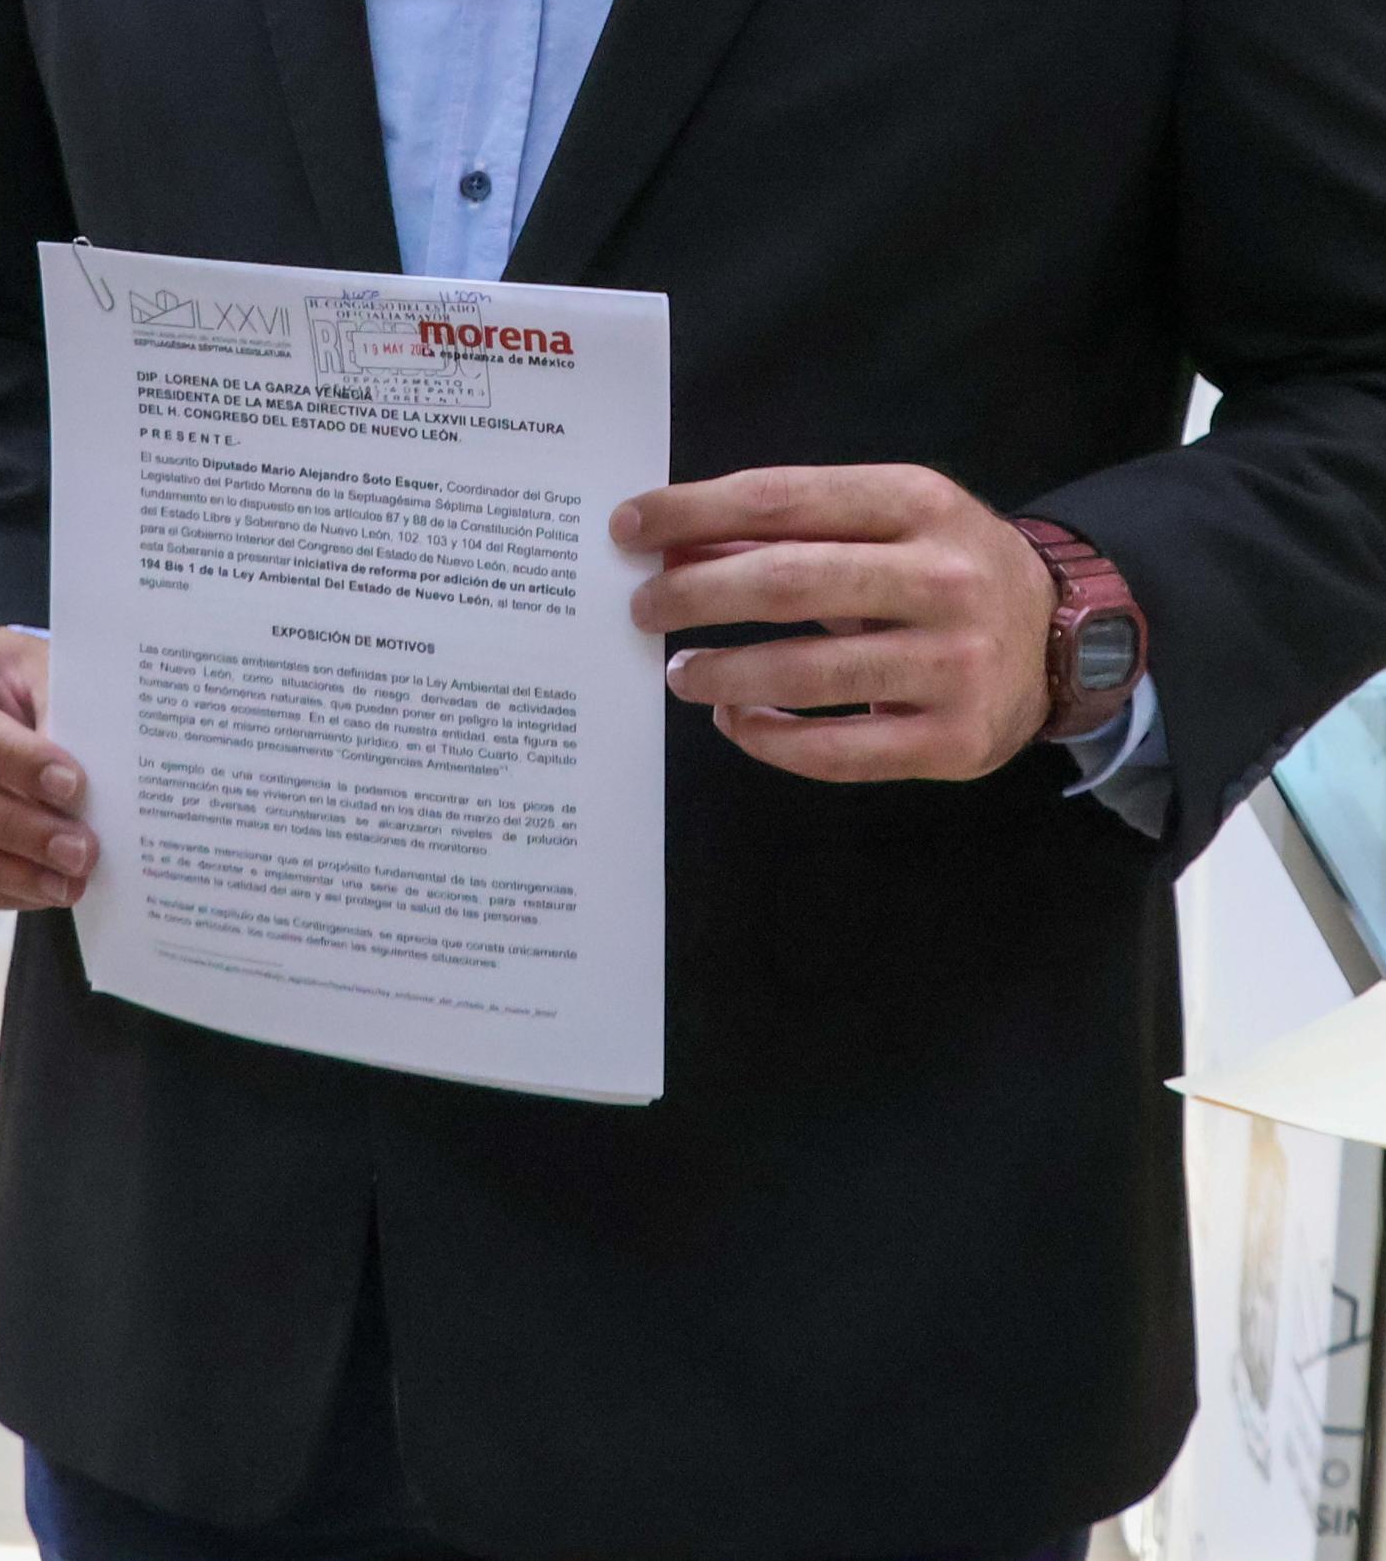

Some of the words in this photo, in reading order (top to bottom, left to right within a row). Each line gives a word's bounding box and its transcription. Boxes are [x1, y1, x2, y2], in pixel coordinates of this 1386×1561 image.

[195, 299, 291, 337] LXXVII
[418, 320, 574, 355] morena
[383, 342, 405, 356] MAY
[420, 346, 436, 358] La
[439, 348, 505, 365] esperanza
[508, 352, 524, 365] de
[527, 354, 576, 370] México
[163, 372, 220, 388] LORENA
[221, 377, 241, 391] DE
[243, 379, 262, 392] LA
[264, 381, 312, 396] GARZA
[136, 385, 221, 405] PRESIDENTA
[222, 393, 242, 407] DE
[243, 396, 263, 409] LA
[264, 397, 304, 412] MESA
[305, 400, 378, 418] DIRECTIVA
[379, 407, 399, 421] DE
[401, 409, 421, 422] LA
[423, 411, 467, 427] LXXVII
[468, 415, 565, 435] LEGISLATURA
[137, 402, 163, 416] DEL
[182, 406, 260, 425] CONGRESO
[261, 413, 286, 427] DEL
[290, 416, 347, 433] ESTADO
[348, 421, 368, 435] DE
[370, 423, 419, 439] NUEVO
[139, 450, 153, 463] El
[153, 454, 200, 468] suscrito
[201, 456, 259, 474] Diputado
[260, 462, 297, 478] Mario
[298, 466, 360, 484] Alejandro
[361, 472, 392, 487] Soto
[394, 474, 443, 493] Esquer,
[445, 480, 520, 499] Coordinador
[521, 489, 542, 501] del
[543, 490, 582, 506] Grupo
[139, 468, 202, 485] Legislativo
[202, 476, 222, 487] del
[223, 476, 266, 492] Partido
[267, 481, 313, 497] Morena
[314, 486, 331, 499] de
[332, 488, 345, 500] la
[346, 488, 432, 509] Septuagésima
[434, 497, 484, 514] Séptima
[557, 512, 581, 524] con
[139, 485, 209, 504] fundamento
[208, 495, 226, 506] en
[225, 494, 238, 507] lo
[238, 496, 296, 513] dispuesto
[295, 504, 313, 515] en
[313, 504, 332, 517] los
[384, 510, 401, 523] 87
[411, 513, 428, 527] 88
[428, 516, 446, 529] de
[446, 517, 459, 530] la
[459, 518, 534, 538] Constitución
[534, 525, 580, 543] Política
[139, 504, 159, 517] del
[159, 505, 201, 522] Estado
[201, 510, 232, 524] Libre
[243, 513, 301, 532] Soberano
[301, 520, 318, 533] de
[319, 521, 359, 538] Nuevo
[426, 533, 448, 547] 103
[461, 537, 483, 550] 104
[484, 540, 505, 553] del
[505, 541, 579, 562] Reglamento
[139, 523, 167, 535] para
[166, 526, 180, 537] el
[179, 525, 234, 542] Gobierno
[234, 532, 276, 547] Interior
[276, 536, 296, 549] del
[296, 538, 355, 556] Congreso
[355, 544, 375, 557] del
[375, 545, 418, 563] Estado
[418, 551, 435, 564] de
[435, 552, 475, 569] Nuevo
[511, 563, 550, 577] acudo
[549, 568, 578, 580] ante
[235, 551, 292, 566] presentar
[292, 556, 349, 573] iniciativa
[349, 562, 367, 575] de
[367, 564, 418, 580] reforma
[418, 571, 441, 583] por
[442, 573, 490, 588] adición
[490, 577, 508, 591] de
[508, 582, 527, 593] un
[140, 556, 161, 570] 194
[163, 559, 185, 574] Bis
[198, 563, 215, 576] de
[217, 565, 230, 578] la
[231, 567, 255, 583] Ley
[257, 570, 321, 588] Ambiental
[323, 576, 346, 590] Del
[347, 579, 393, 596] Estado
[394, 585, 412, 598] de
[414, 586, 456, 603] Nuevo
[496, 597, 509, 609] al
[511, 598, 543, 612] tenor
[545, 602, 562, 615] de
[564, 604, 577, 616] la
[270, 624, 352, 645] EXPOSICIÓN
[353, 633, 373, 648] DE
[374, 636, 436, 655] MOTIVOS
